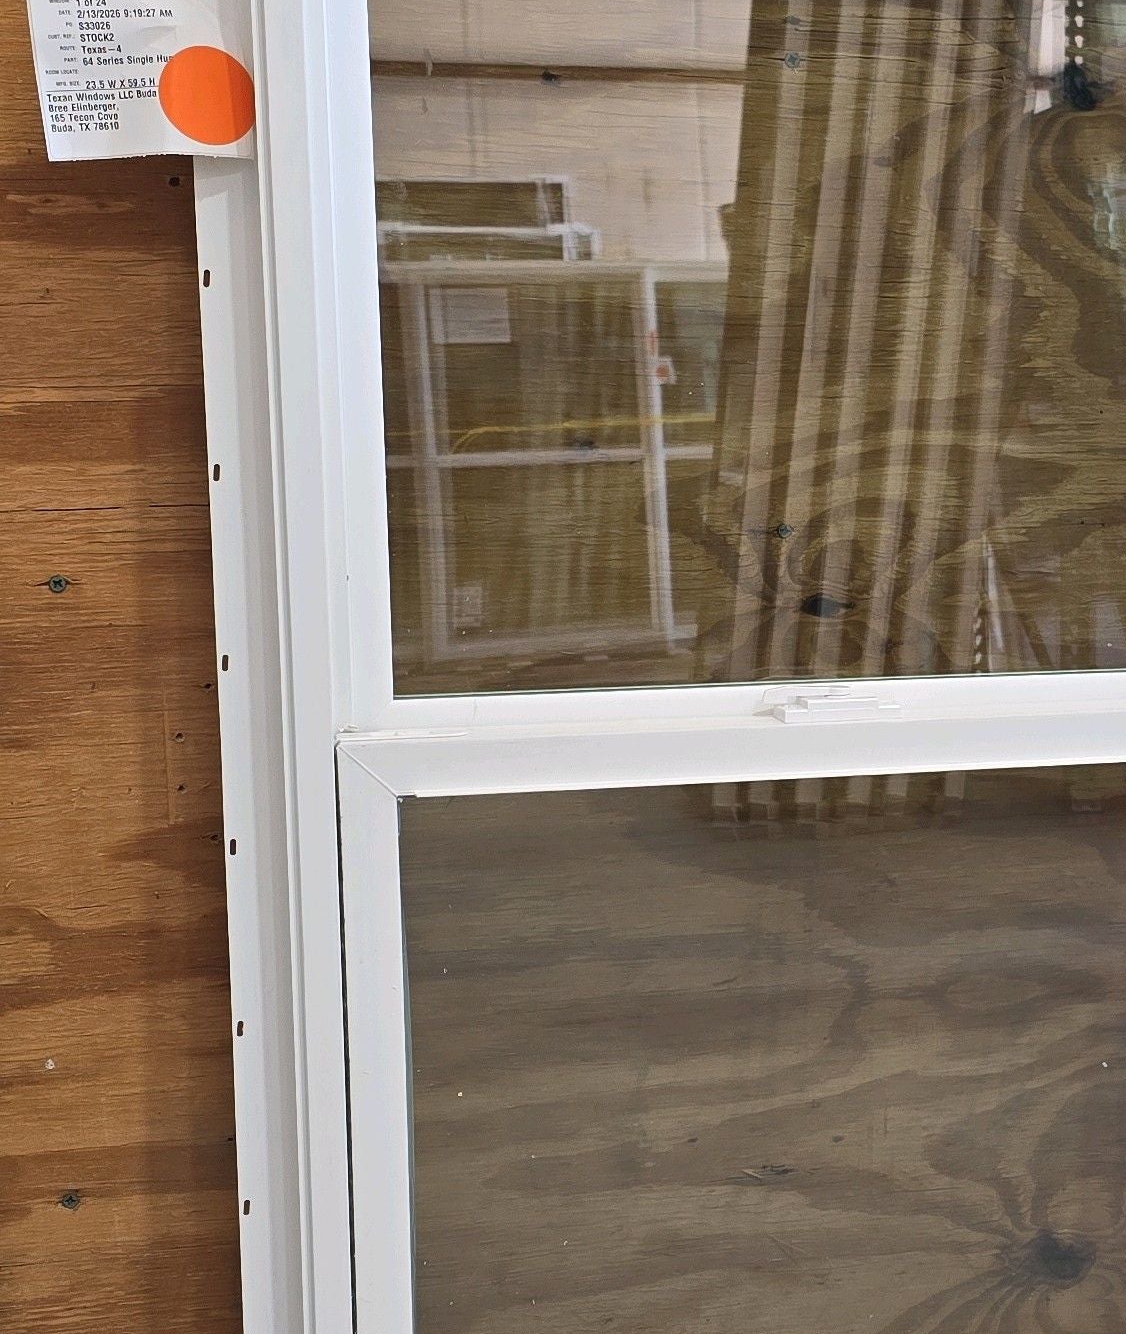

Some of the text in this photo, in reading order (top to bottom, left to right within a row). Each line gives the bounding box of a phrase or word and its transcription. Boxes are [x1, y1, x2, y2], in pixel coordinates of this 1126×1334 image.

[123, 8, 156, 18] 9:19:27
[159, 9, 173, 17] AM
[78, 21, 111, 31] S33026
[80, 33, 115, 43] STOCK2
[83, 57, 93, 66] 64
[96, 56, 124, 66] Series
[127, 55, 154, 66] Single
[86, 80, 105, 90] 23.5
[107, 80, 116, 89] W
[120, 79, 125, 87] X
[128, 78, 146, 87] 59.5
[149, 77, 156, 86] H
[47, 89, 157, 103] Texan Windows LLC Buda
[48, 104, 68, 113] Bree
[50, 114, 66, 122] 165
[97, 112, 119, 121] Cove
[51, 121, 119, 133] Buda, TX 78610
